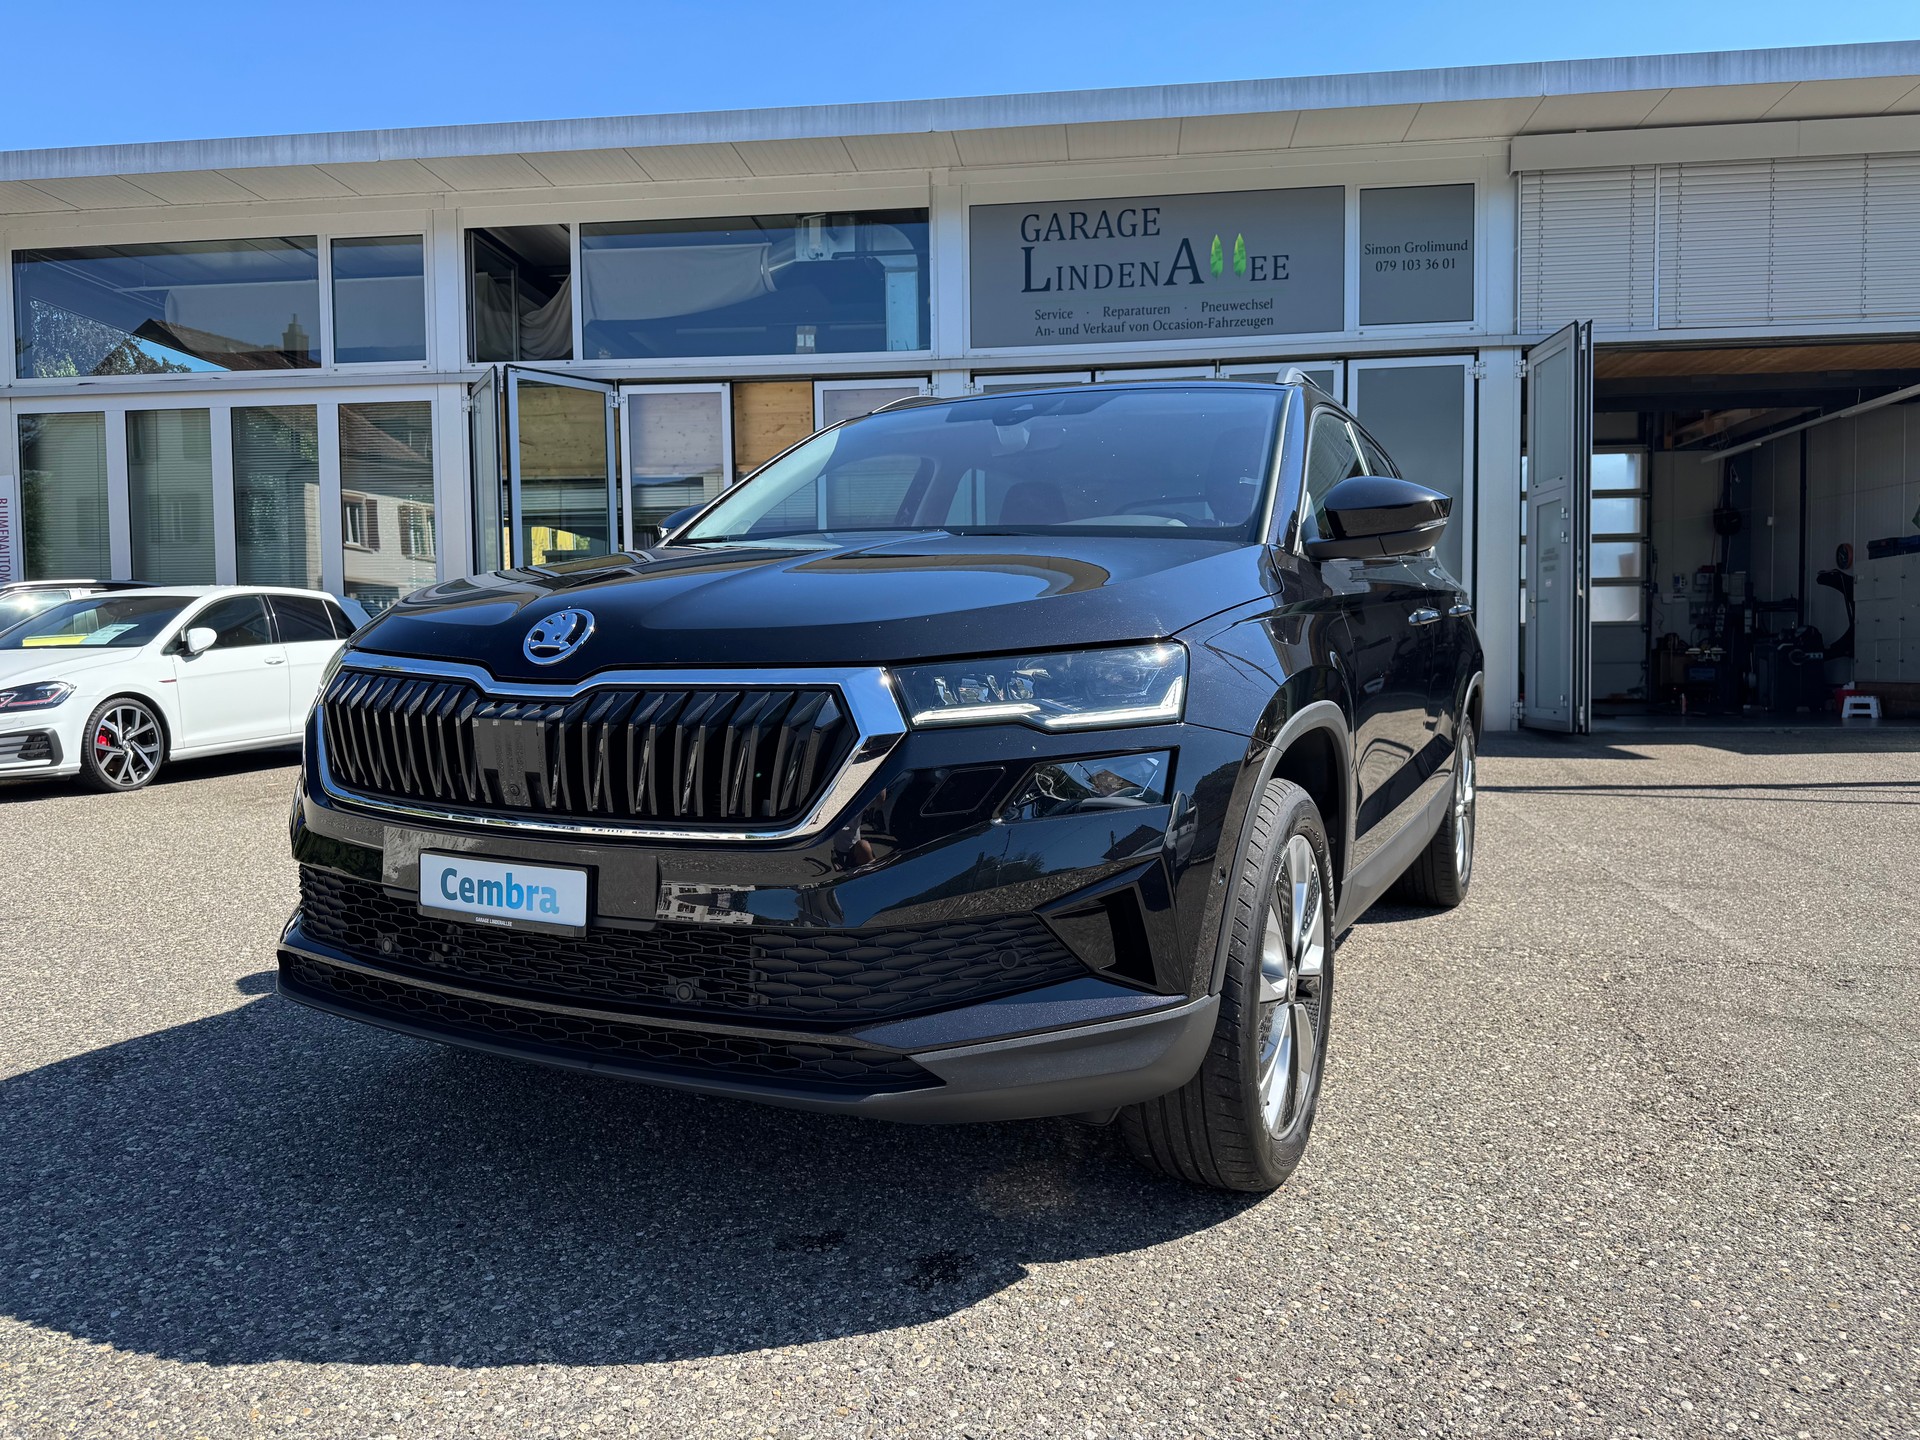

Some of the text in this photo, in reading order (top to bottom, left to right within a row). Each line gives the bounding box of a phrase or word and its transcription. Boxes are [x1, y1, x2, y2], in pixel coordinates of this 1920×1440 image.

[1021, 207, 1160, 242] GARAGE
[1364, 239, 1468, 255] Simon Grolimund
[1375, 257, 1455, 272] 079 103 36 01
[1034, 297, 1273, 320] Service Reparaturen Pneuwechsel
[1034, 316, 1274, 336] An- und Verkauf von Occasion-Fahrzeugen
[440, 867, 560, 914] Cembra
